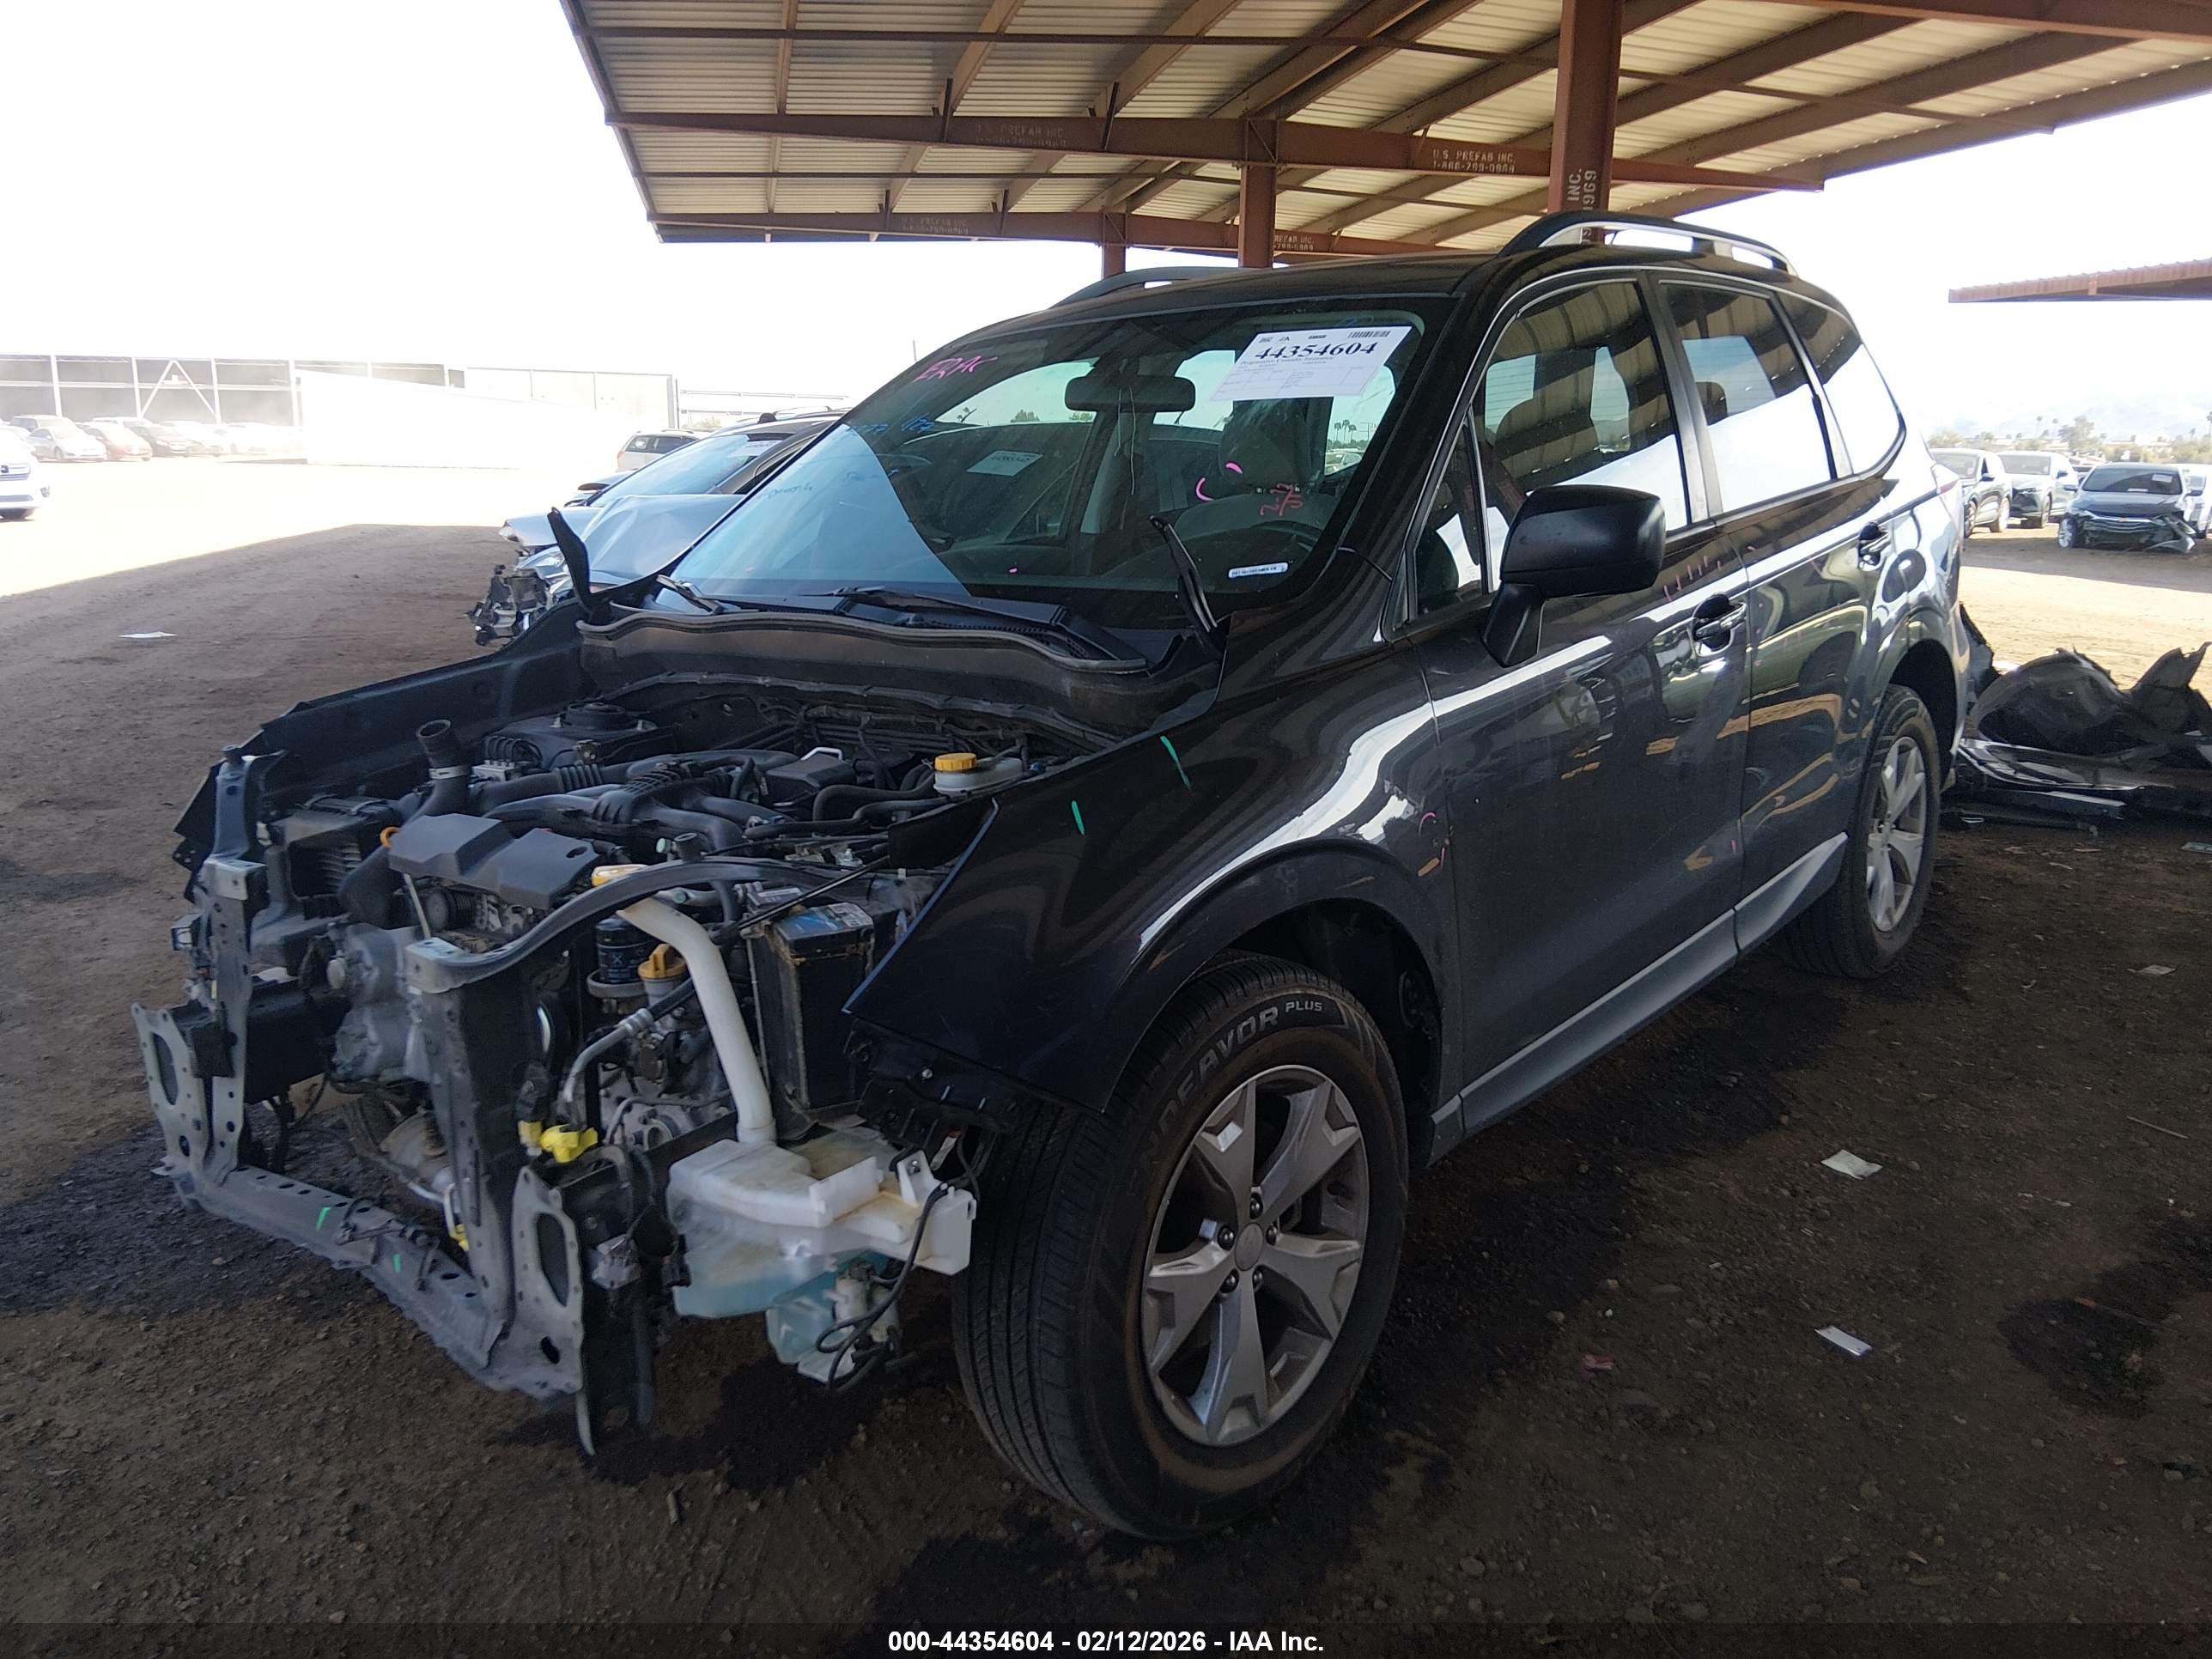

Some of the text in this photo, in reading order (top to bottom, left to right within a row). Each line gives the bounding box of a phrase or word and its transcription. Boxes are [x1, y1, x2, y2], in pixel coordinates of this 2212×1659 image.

[1455, 150, 1493, 162] PREFAB
[1566, 168, 1583, 202] INC.
[1255, 342, 1379, 360] 44354604
[1285, 1000, 1323, 1013] PLUS
